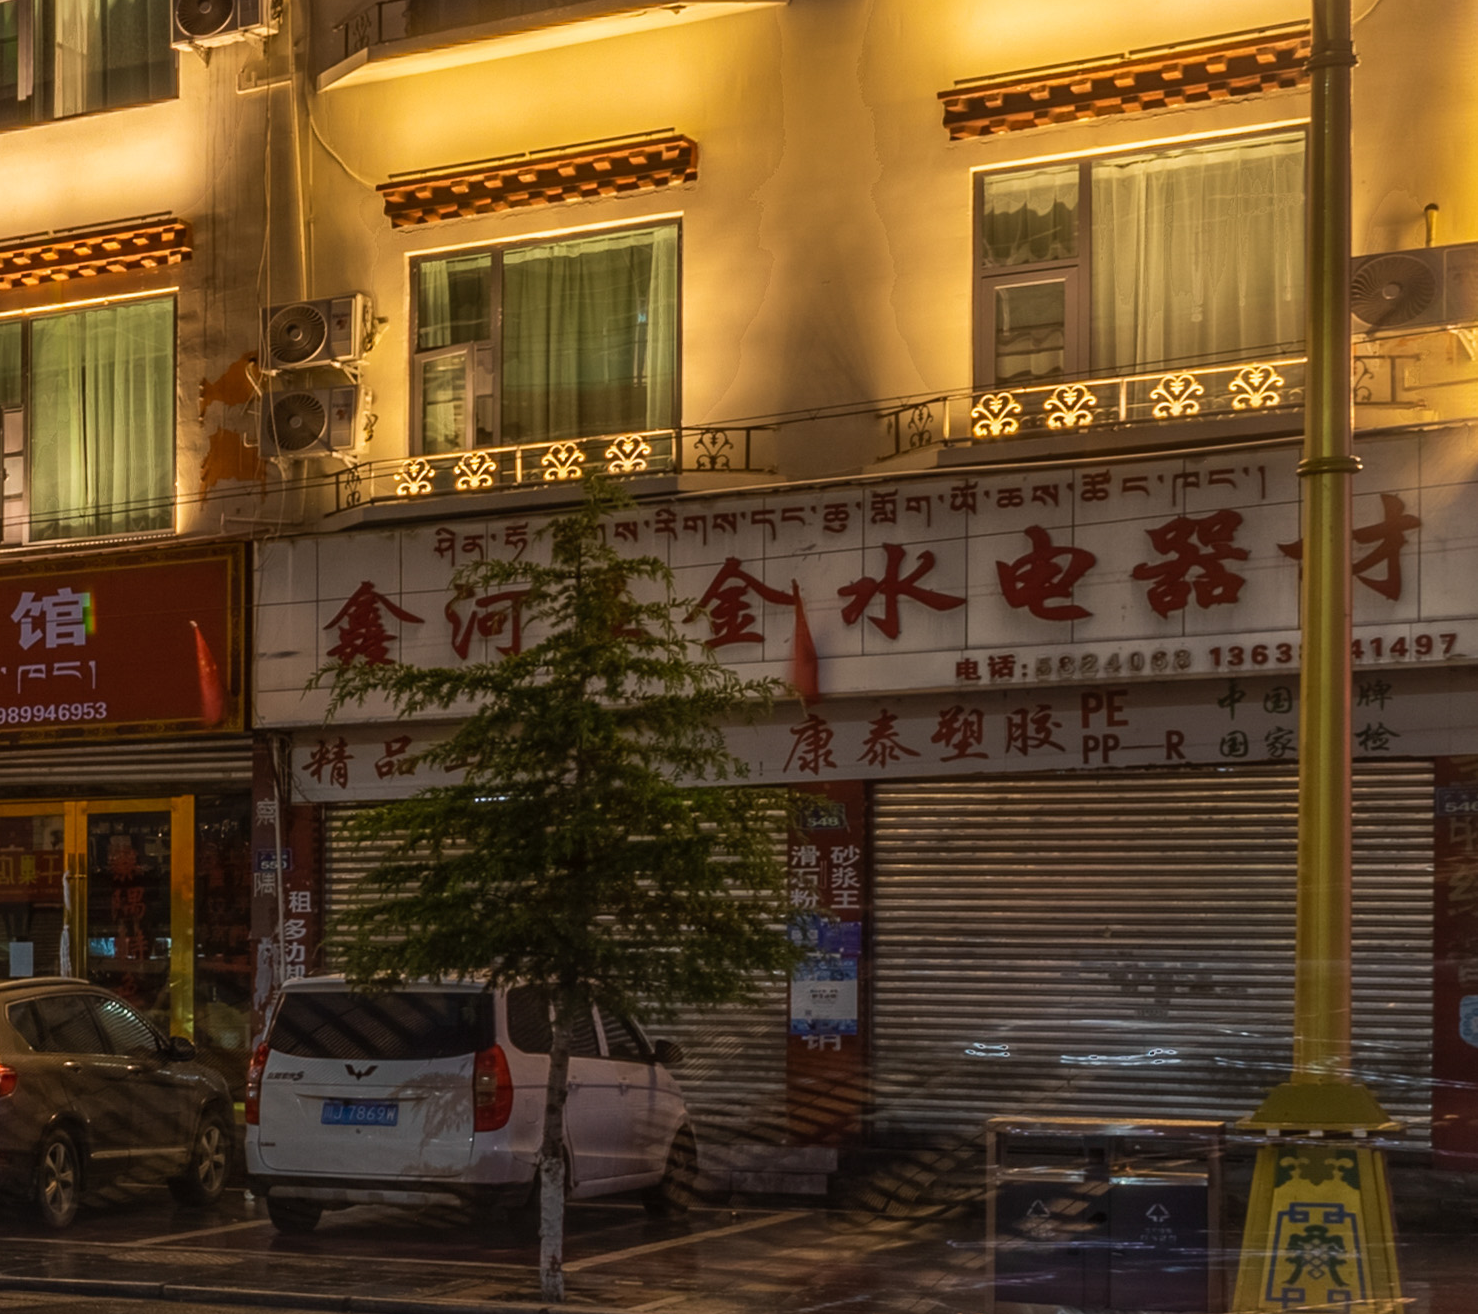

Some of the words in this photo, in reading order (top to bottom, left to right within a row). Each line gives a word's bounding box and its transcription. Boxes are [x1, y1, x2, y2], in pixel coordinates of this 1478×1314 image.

[323, 494, 1422, 666] 鑫河金水电器材
[782, 703, 1065, 776] 康泰塑胶
[1080, 690, 1129, 729] PE
[829, 844, 861, 910] 砂浆王
